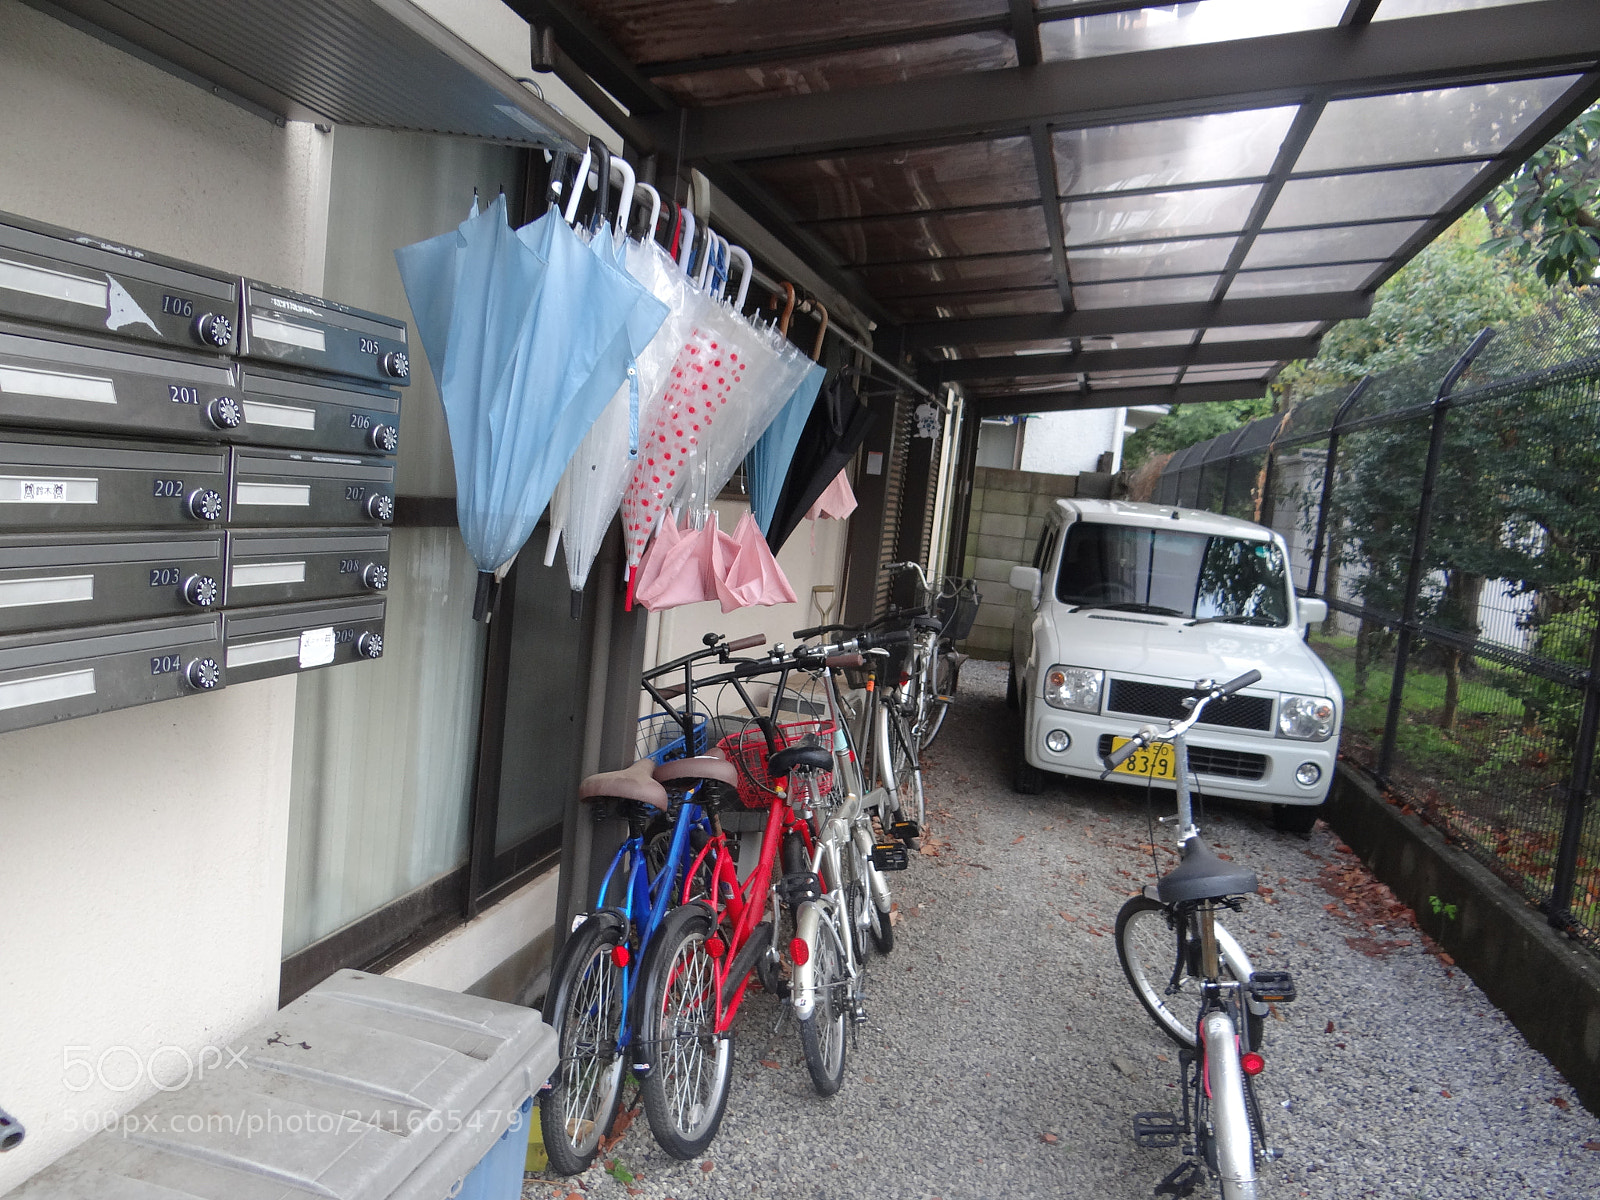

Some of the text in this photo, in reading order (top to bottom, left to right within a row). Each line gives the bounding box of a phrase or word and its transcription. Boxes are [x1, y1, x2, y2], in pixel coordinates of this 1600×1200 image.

[162, 296, 193, 317] 106
[359, 338, 380, 355] 205
[170, 385, 199, 405] 201
[350, 414, 371, 430] 206
[154, 480, 184, 498] 202
[345, 486, 366, 500] 207
[339, 559, 360, 574] 208
[151, 569, 181, 586] 203
[335, 629, 355, 645] 209
[152, 655, 182, 674] 204
